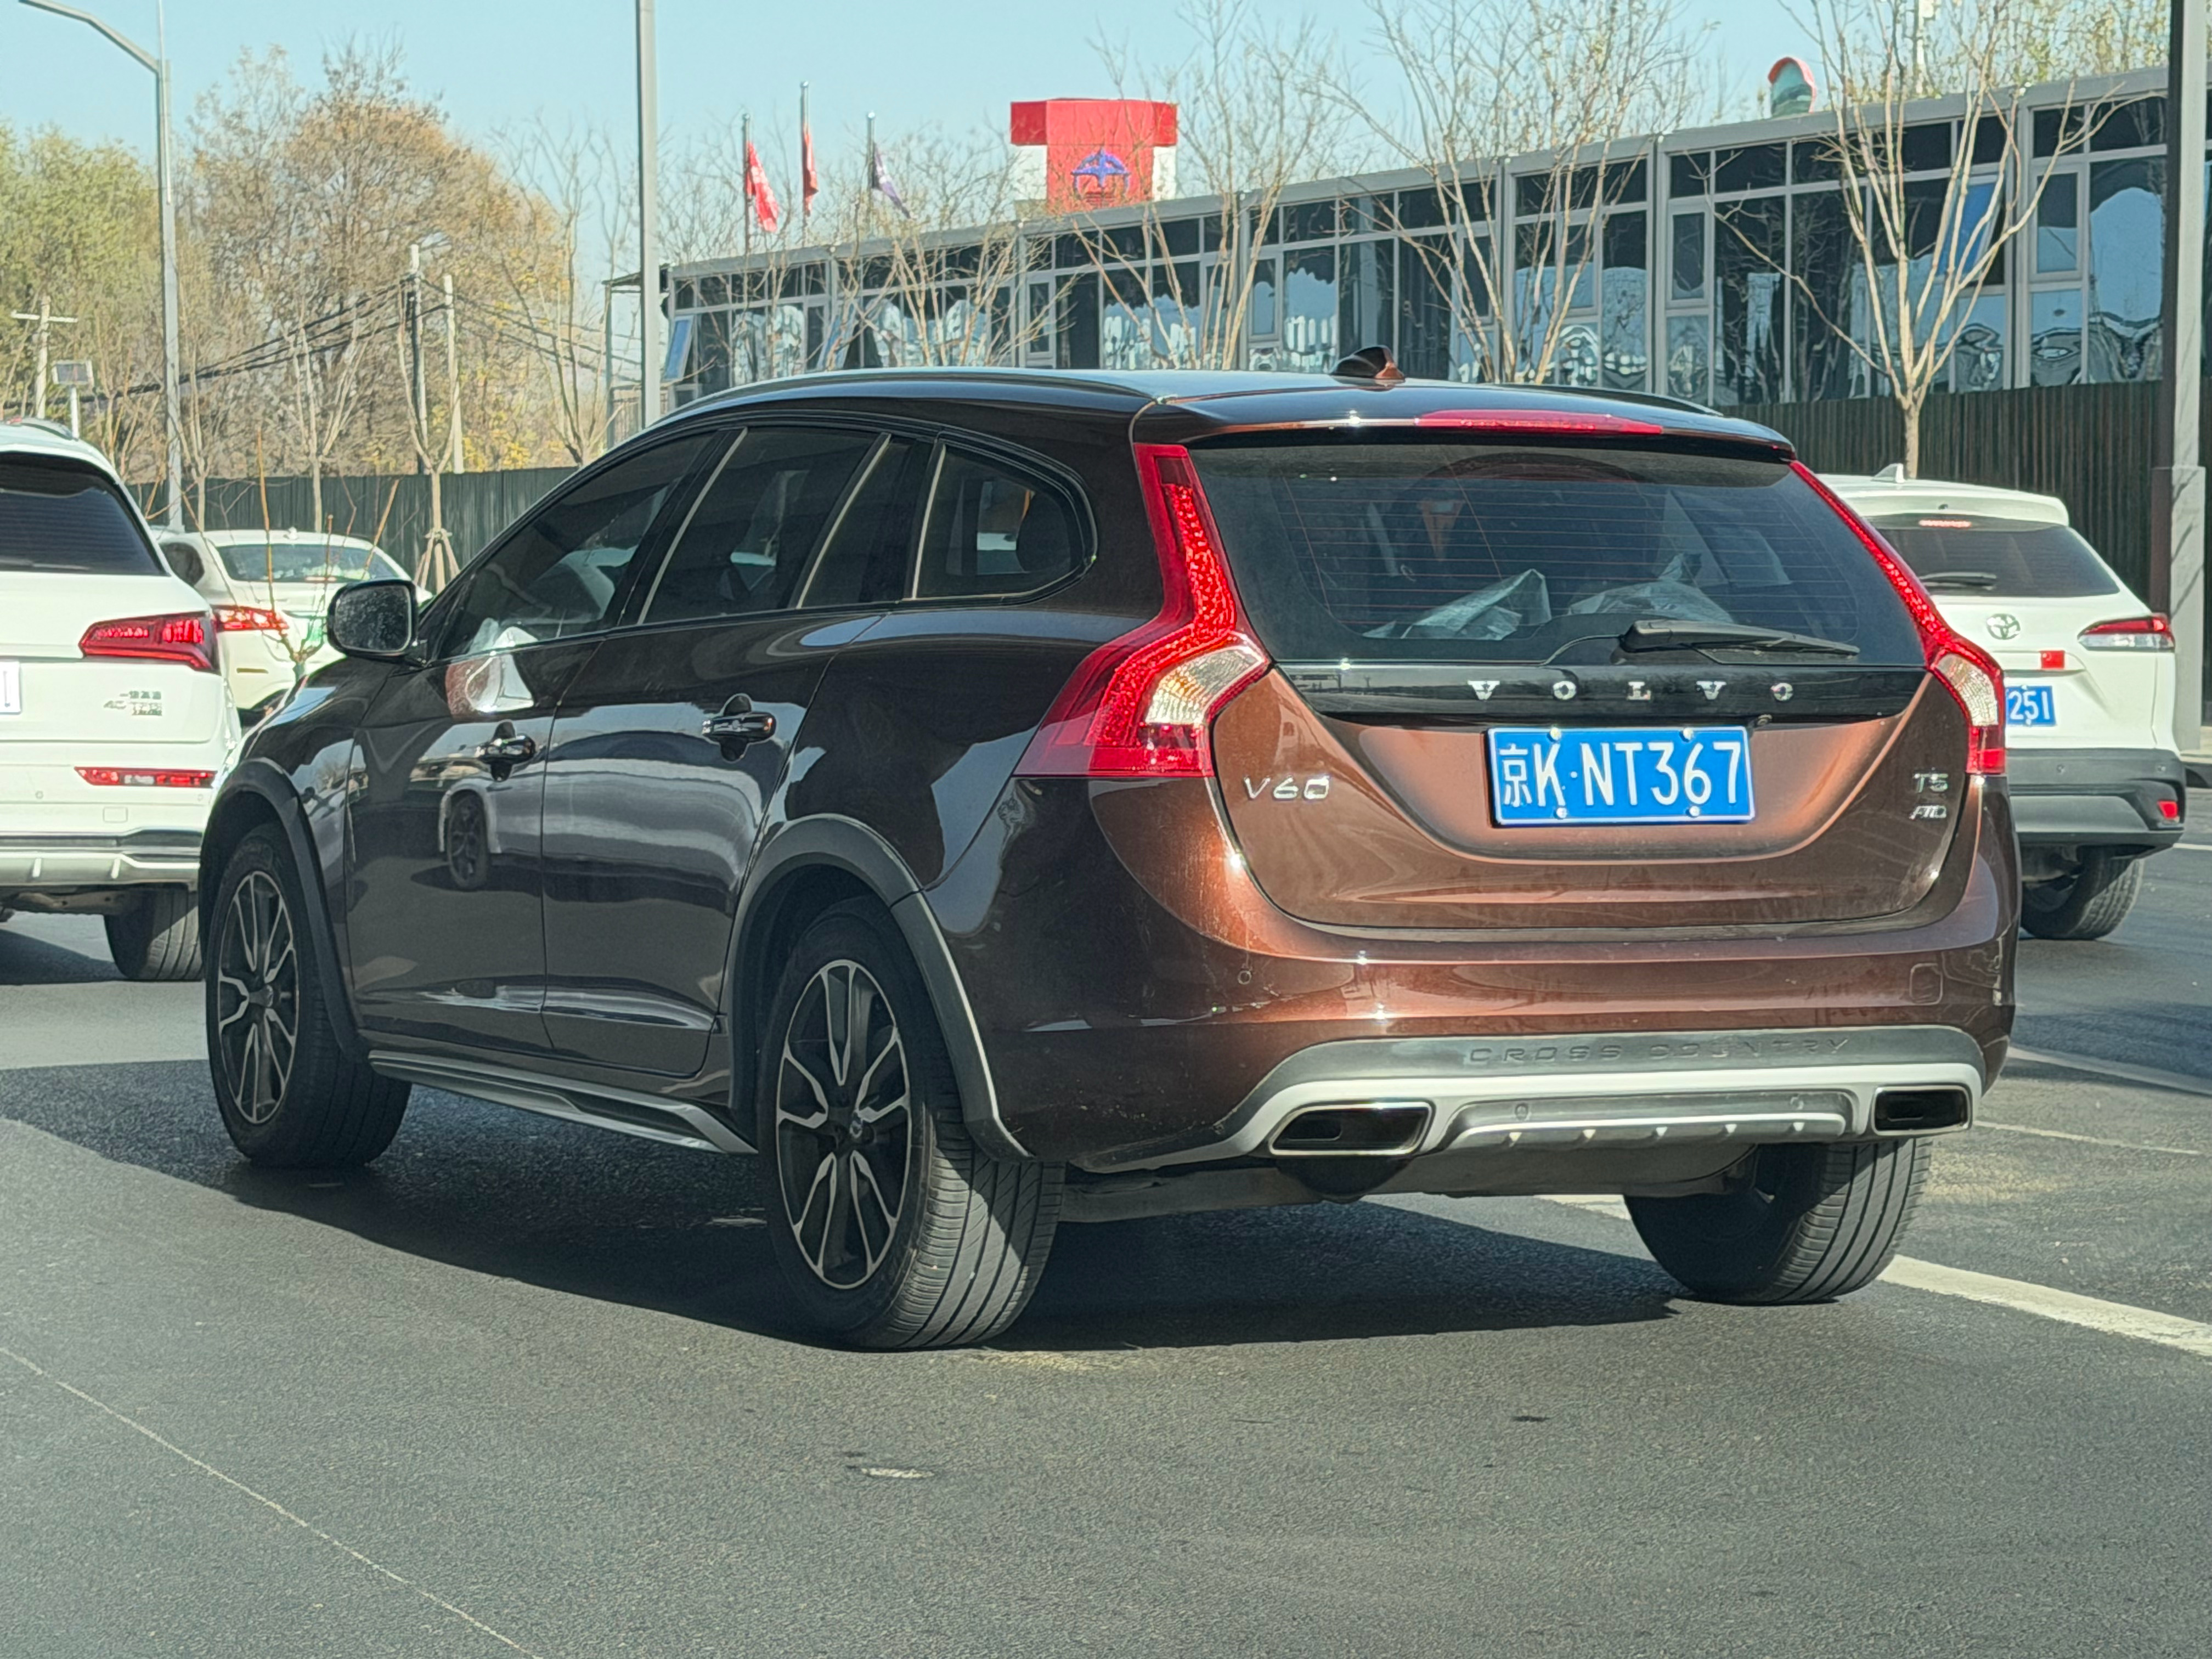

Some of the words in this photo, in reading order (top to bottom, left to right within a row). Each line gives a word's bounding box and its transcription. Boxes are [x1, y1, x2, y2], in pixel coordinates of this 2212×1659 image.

[1467, 680, 1793, 702] VOLVO
[2008, 690, 2051, 720] 251
[1244, 775, 1330, 800] V60
[1912, 773, 1949, 793] T5
[1469, 1044, 1623, 1063] CROSS
[1649, 1037, 1849, 1060] COUNTRY
